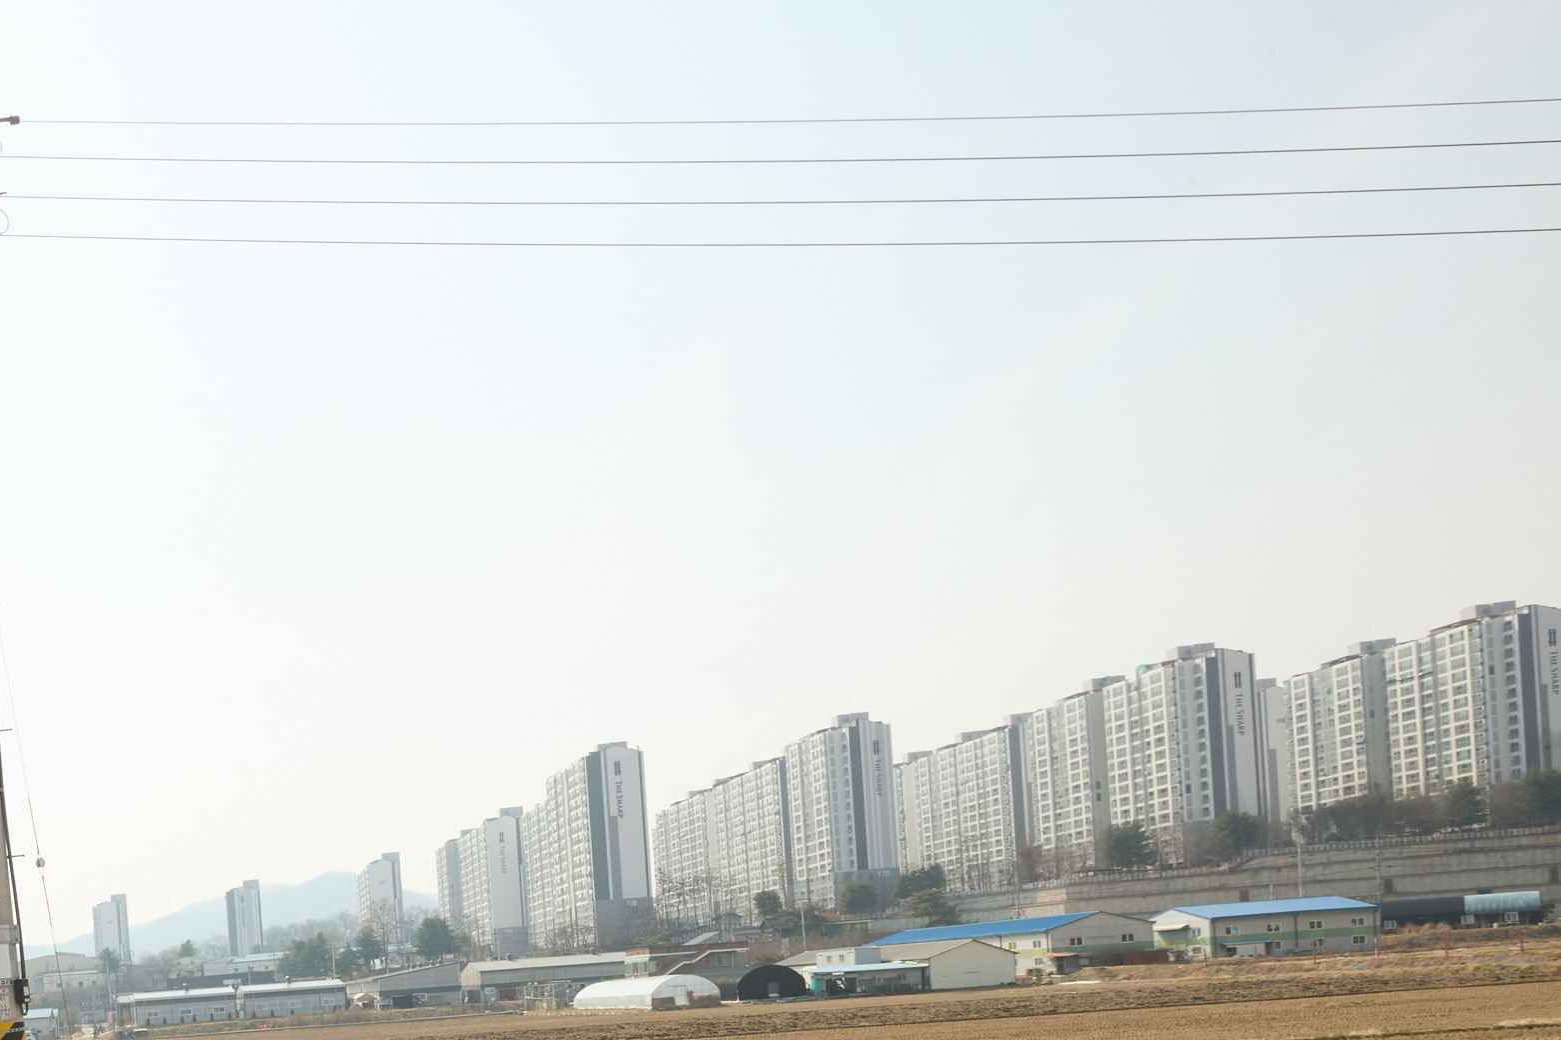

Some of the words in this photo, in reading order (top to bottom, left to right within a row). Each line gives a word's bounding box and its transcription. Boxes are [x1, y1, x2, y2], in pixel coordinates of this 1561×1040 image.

[1550, 667, 1560, 696] SHARP
[1237, 709, 1247, 736] SHARP
[615, 795, 624, 819] SHARP
